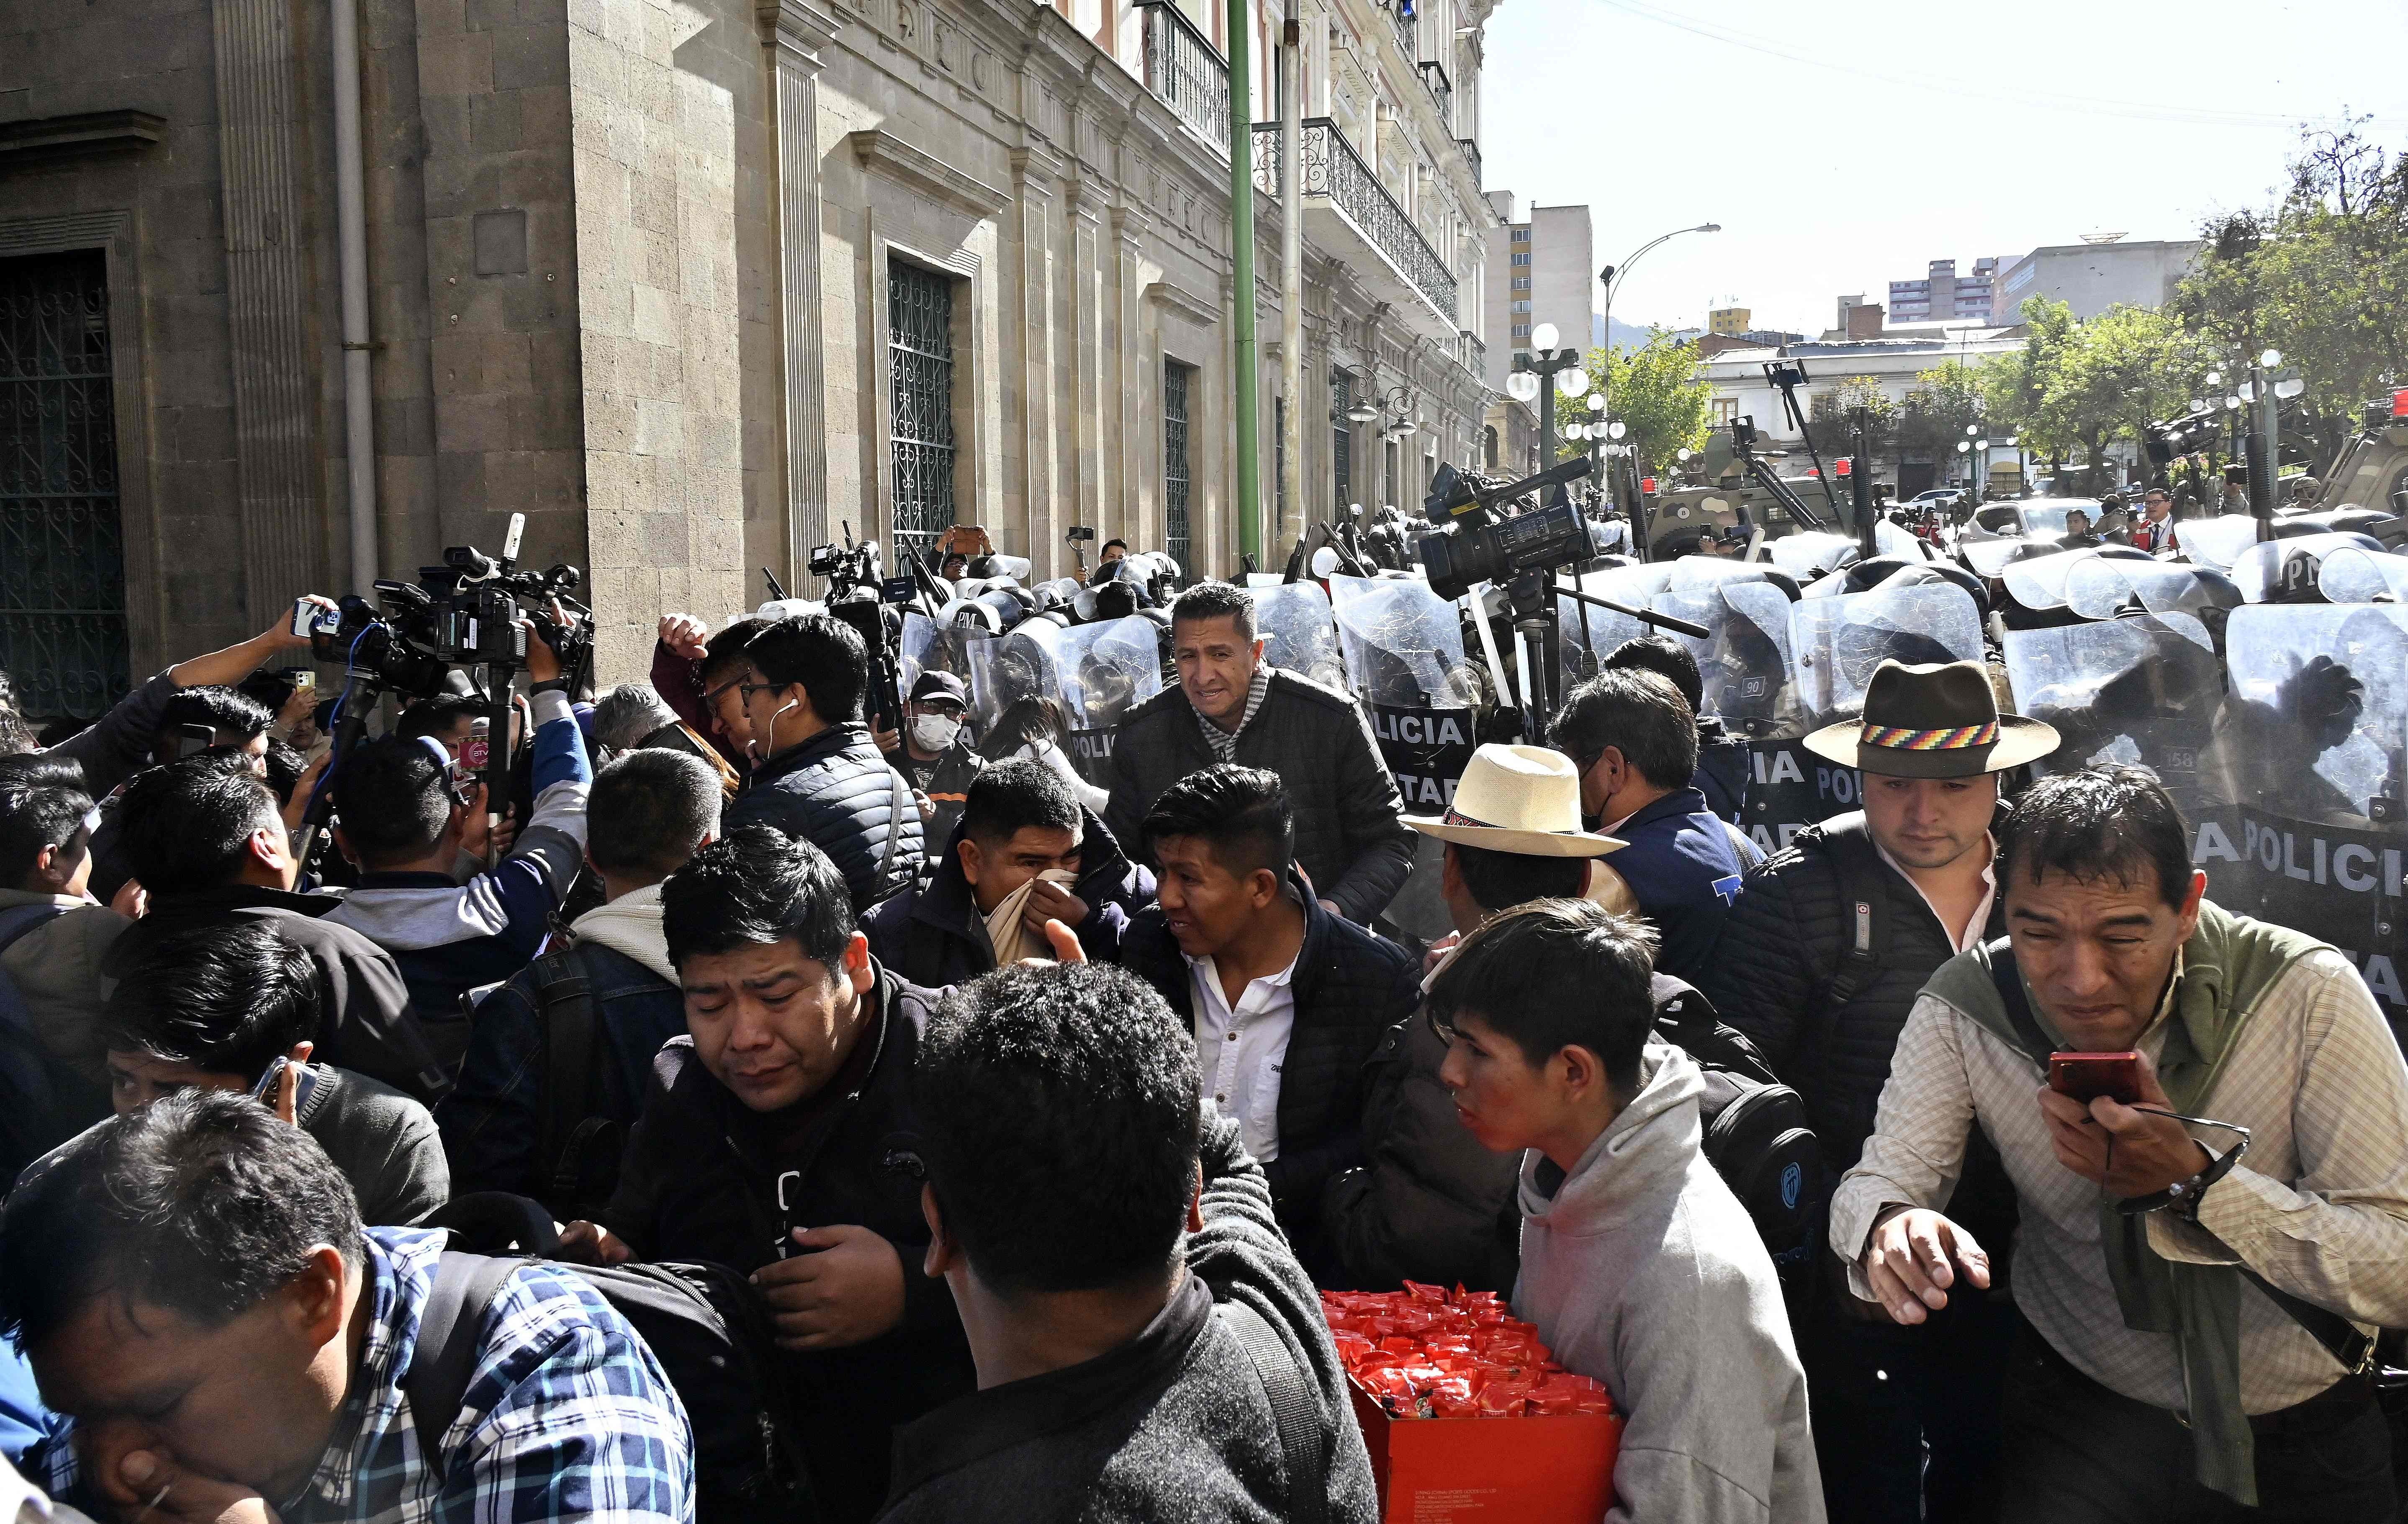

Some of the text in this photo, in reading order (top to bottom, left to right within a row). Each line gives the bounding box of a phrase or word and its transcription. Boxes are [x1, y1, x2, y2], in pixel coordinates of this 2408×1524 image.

[1548, 505, 1564, 513] SONY
[956, 612, 977, 630] PM
[1747, 681, 1759, 693] 90
[1747, 750, 1805, 784] IA
